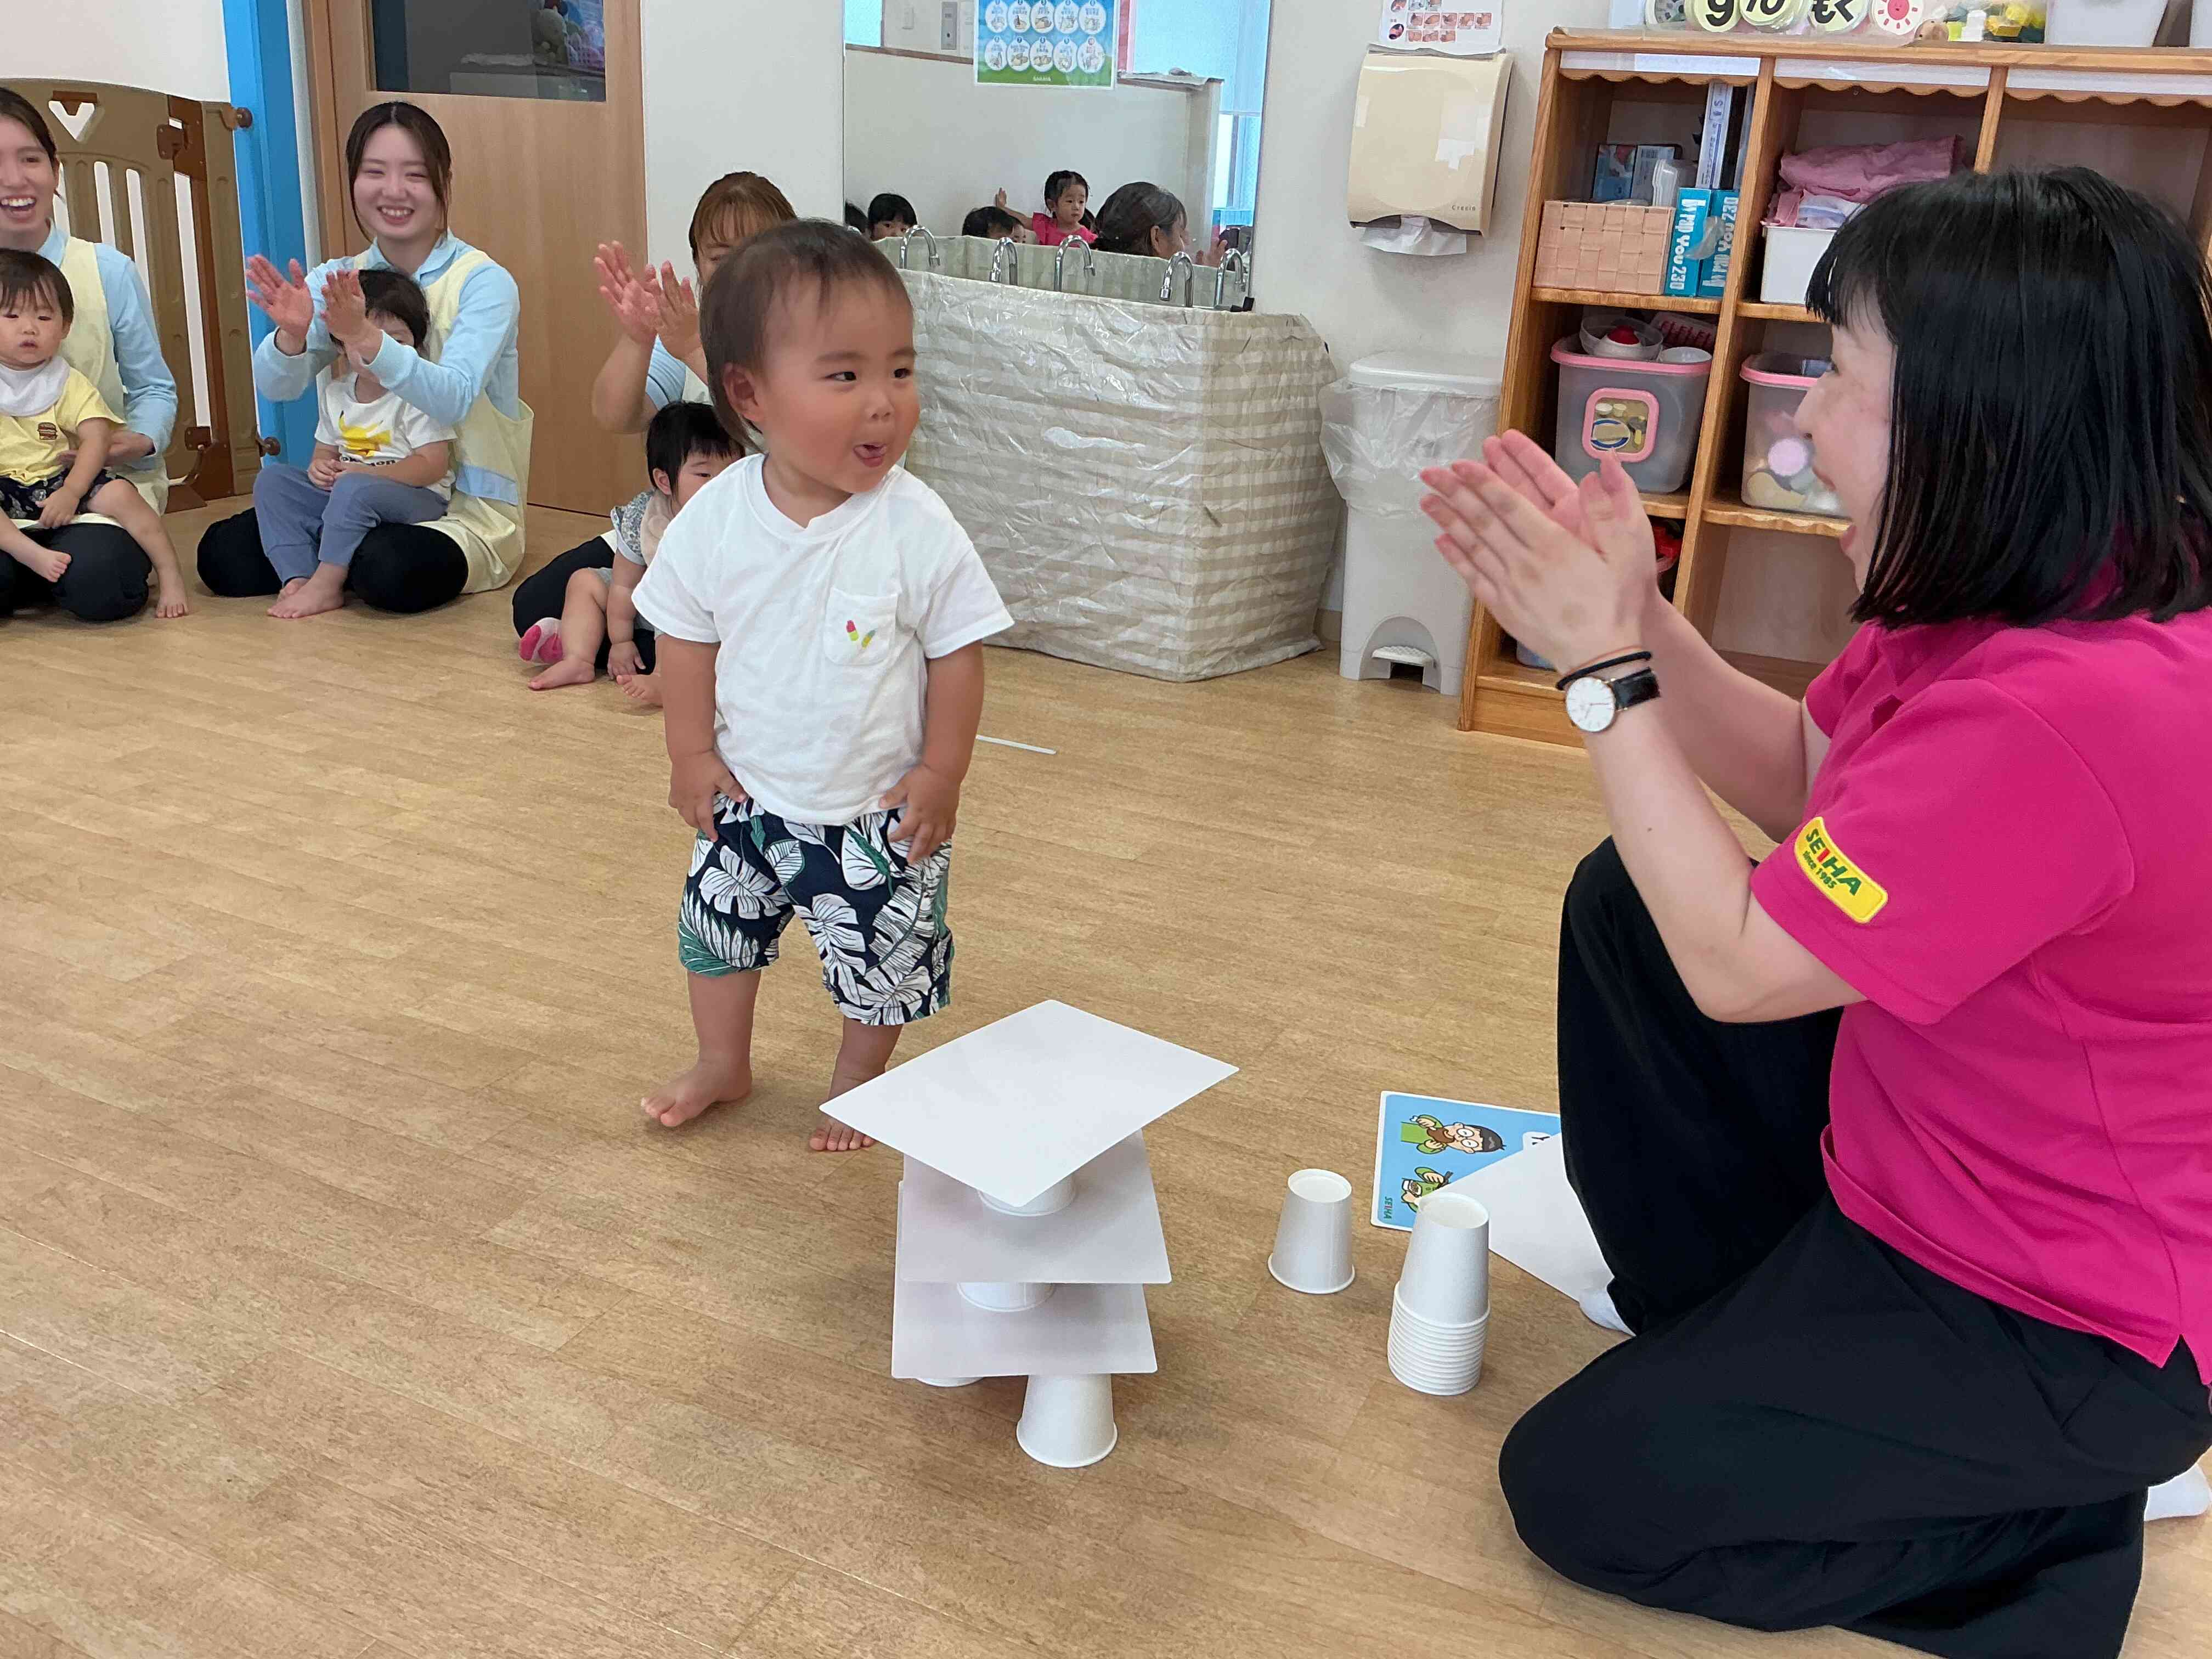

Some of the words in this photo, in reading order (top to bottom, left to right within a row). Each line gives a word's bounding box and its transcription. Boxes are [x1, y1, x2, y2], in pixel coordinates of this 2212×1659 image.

[1669, 266, 1687, 290] 230
[1805, 828, 1861, 896] SEIHA
[1816, 868, 1837, 889] 1985
[1384, 1196, 1393, 1219] SEIHA
